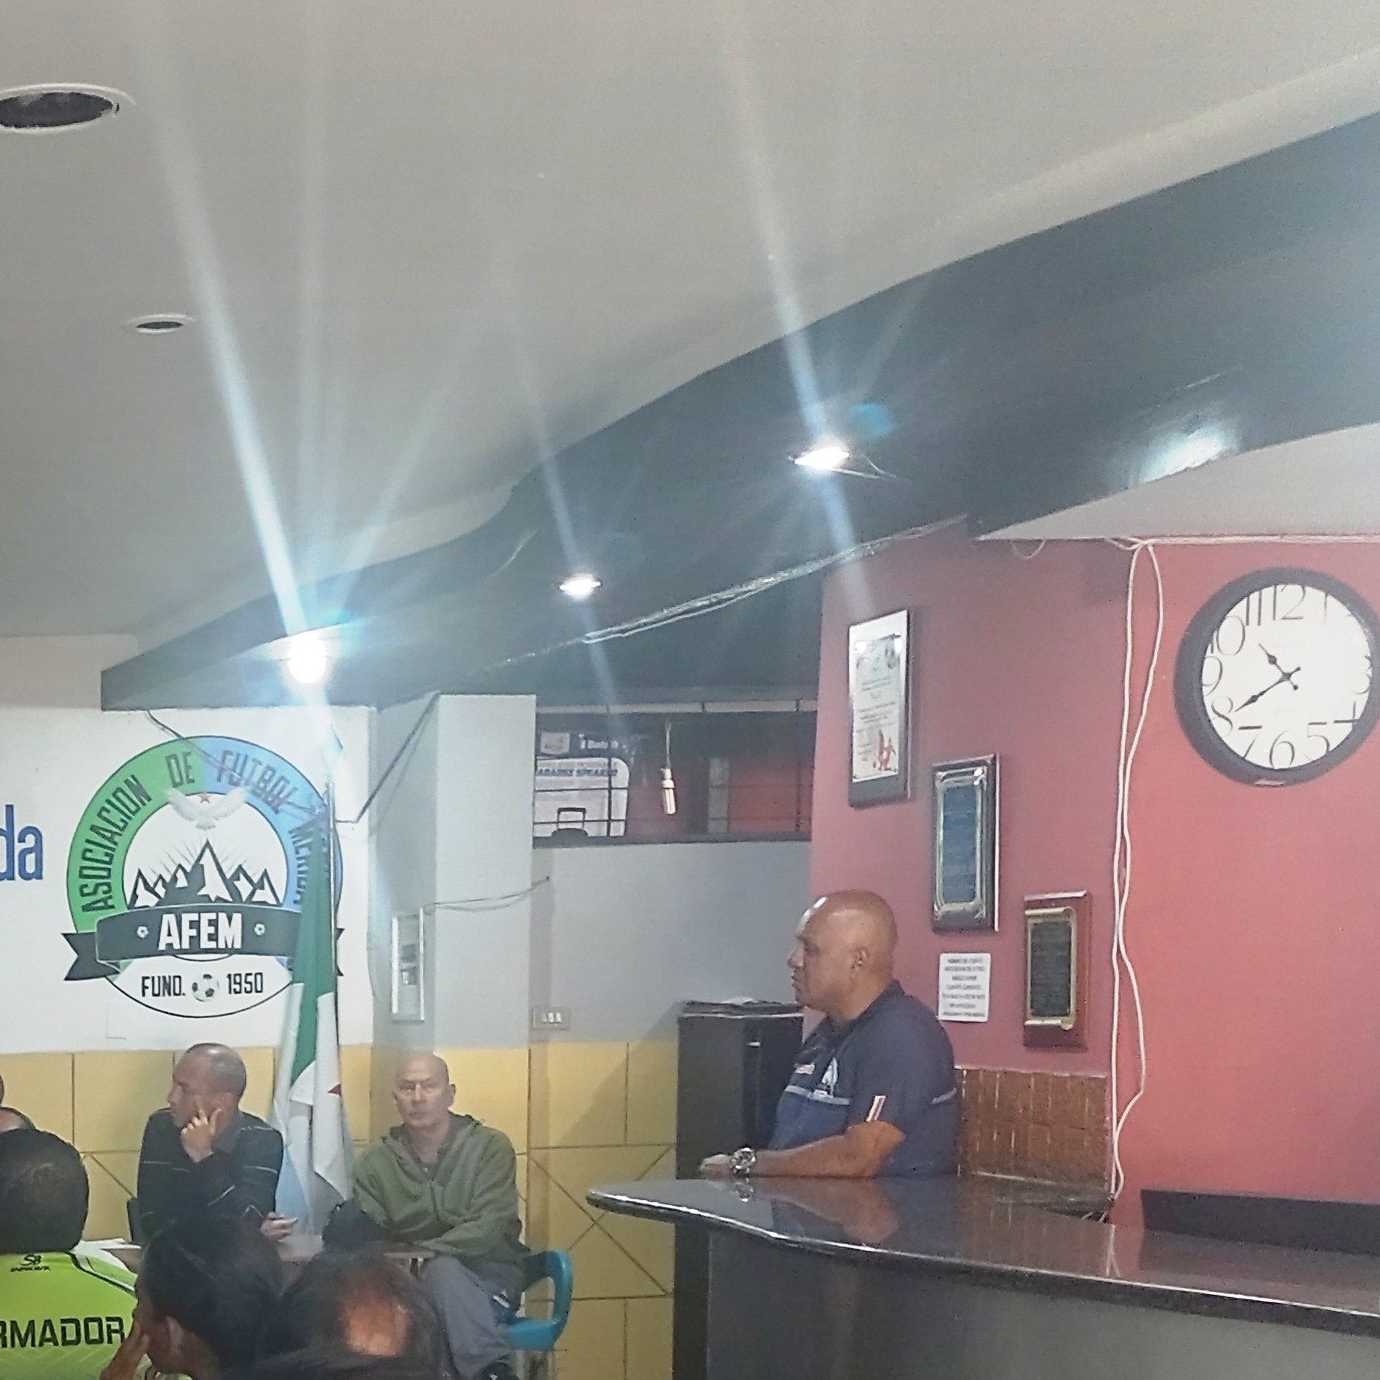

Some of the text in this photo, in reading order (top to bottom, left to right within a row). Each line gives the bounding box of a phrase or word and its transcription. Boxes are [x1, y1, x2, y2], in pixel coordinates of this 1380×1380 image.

[78, 774, 152, 913] ASOCIACION
[165, 751, 195, 788] DE
[157, 912, 243, 950] AFEM
[141, 972, 264, 998] FUND. 1950
